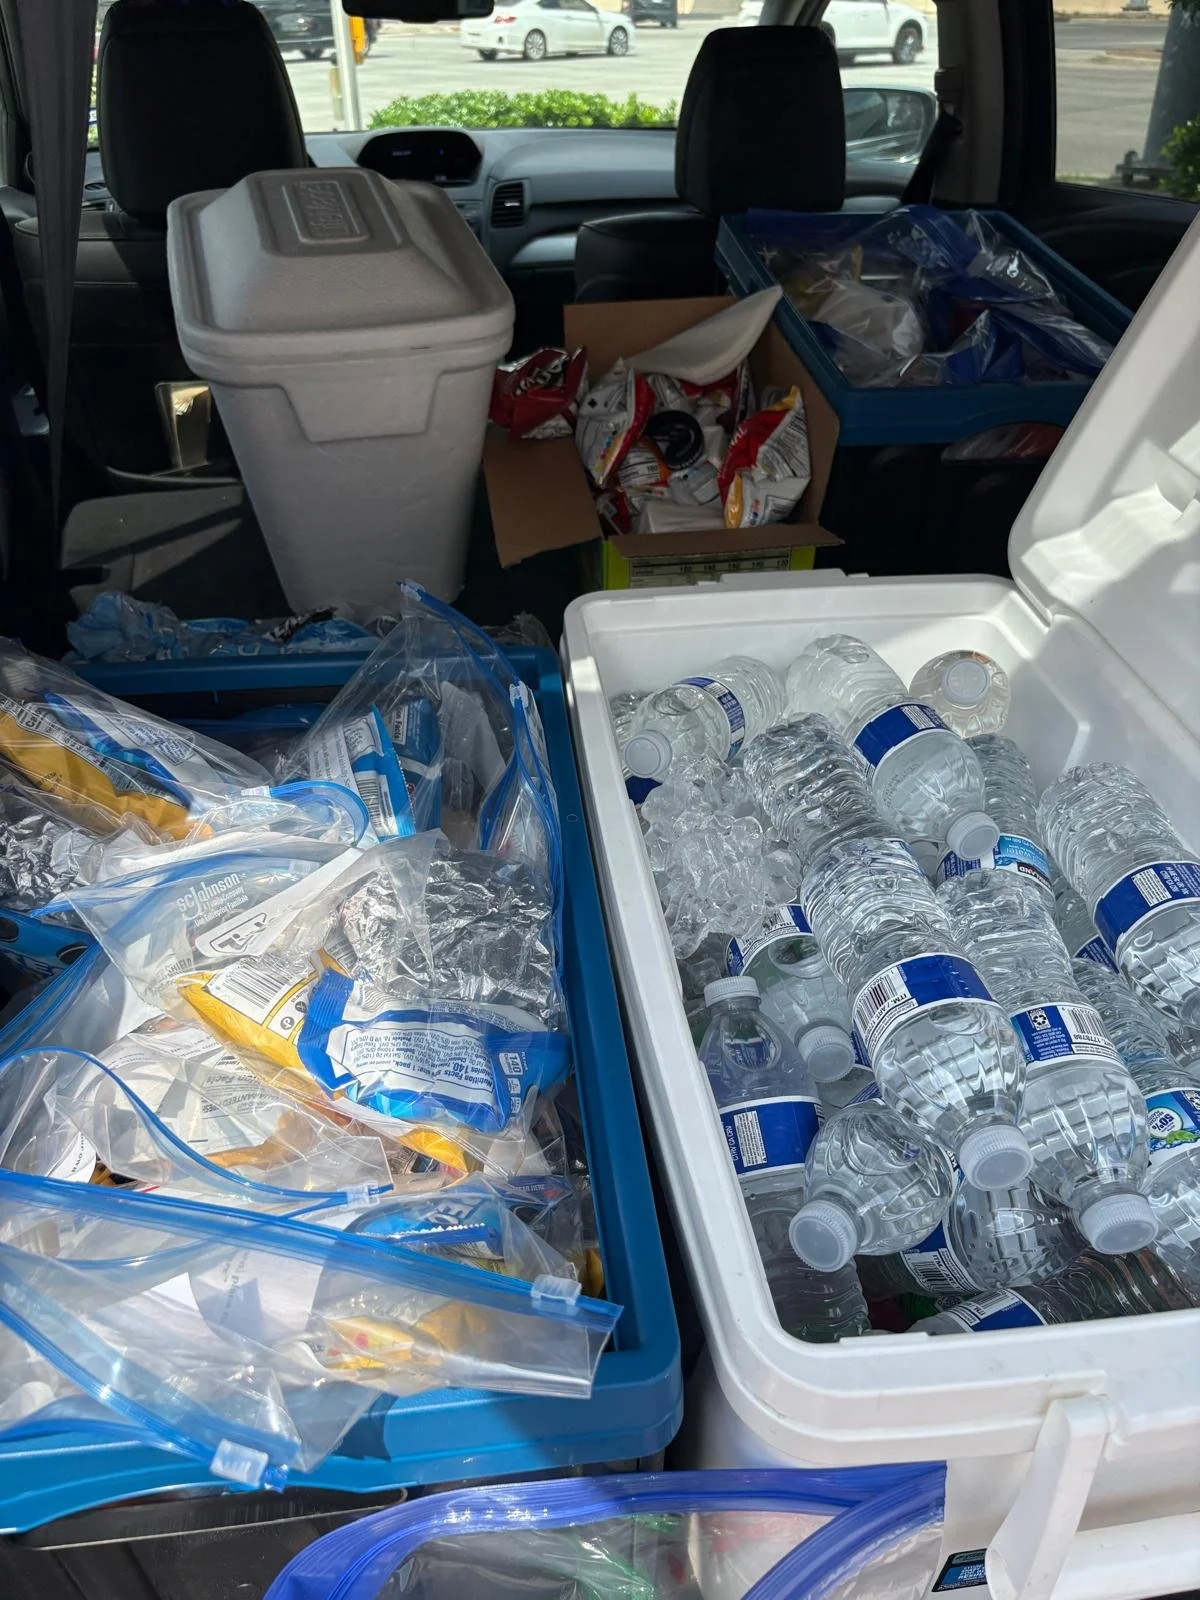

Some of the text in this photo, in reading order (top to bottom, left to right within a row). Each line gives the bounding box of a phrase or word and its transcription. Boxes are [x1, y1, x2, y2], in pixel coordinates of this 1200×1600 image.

[509, 1055, 521, 1073] 140
[444, 1070, 463, 1080] Facts
[464, 1075, 492, 1087] Nutrition
[1152, 1114, 1174, 1130] 50%
